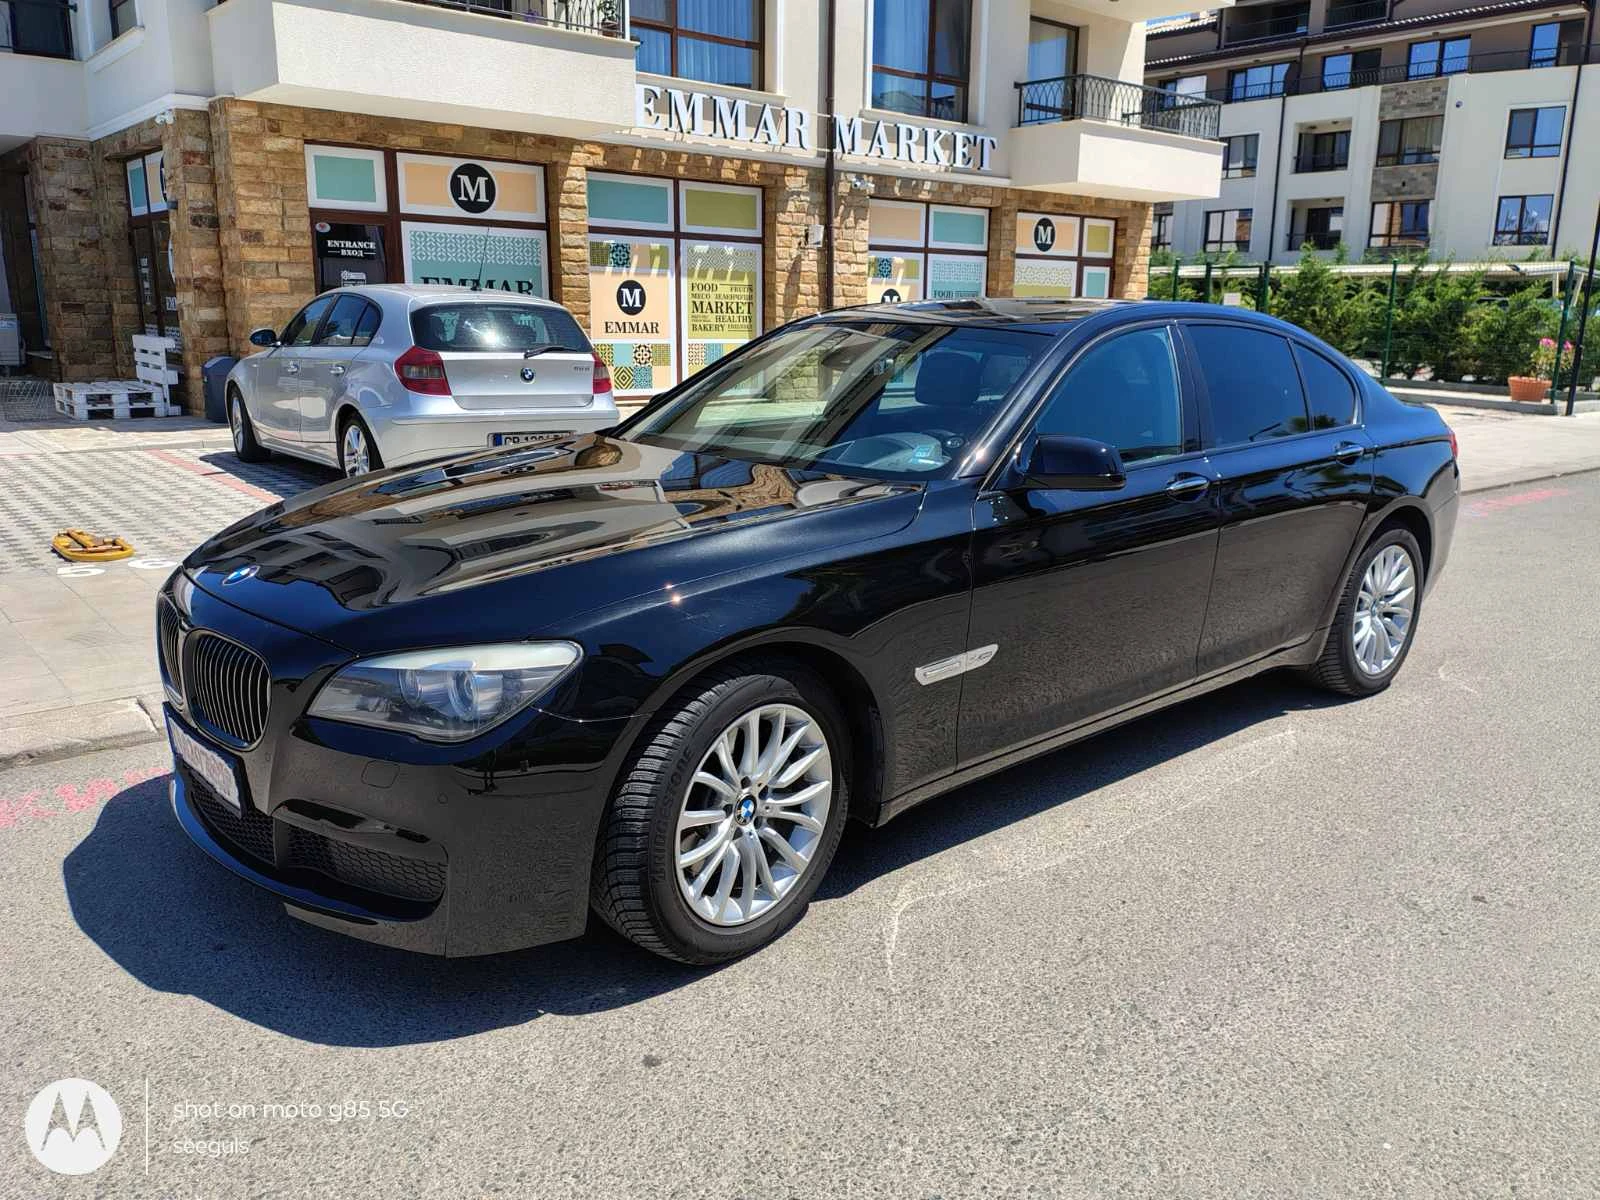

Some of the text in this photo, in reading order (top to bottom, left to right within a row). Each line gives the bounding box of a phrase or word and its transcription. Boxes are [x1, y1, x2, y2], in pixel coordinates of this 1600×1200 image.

[635, 84, 998, 171] EMMAR MARKET
[457, 174, 489, 203] M
[1036, 224, 1053, 245] M
[327, 239, 376, 249] ENTRANCE
[691, 282, 718, 292] FOOD
[620, 288, 642, 308] M
[691, 301, 753, 314] MARKET
[715, 315, 753, 323] HEALTHY
[604, 321, 660, 334] EMMAR
[692, 323, 724, 332] BAKERY
